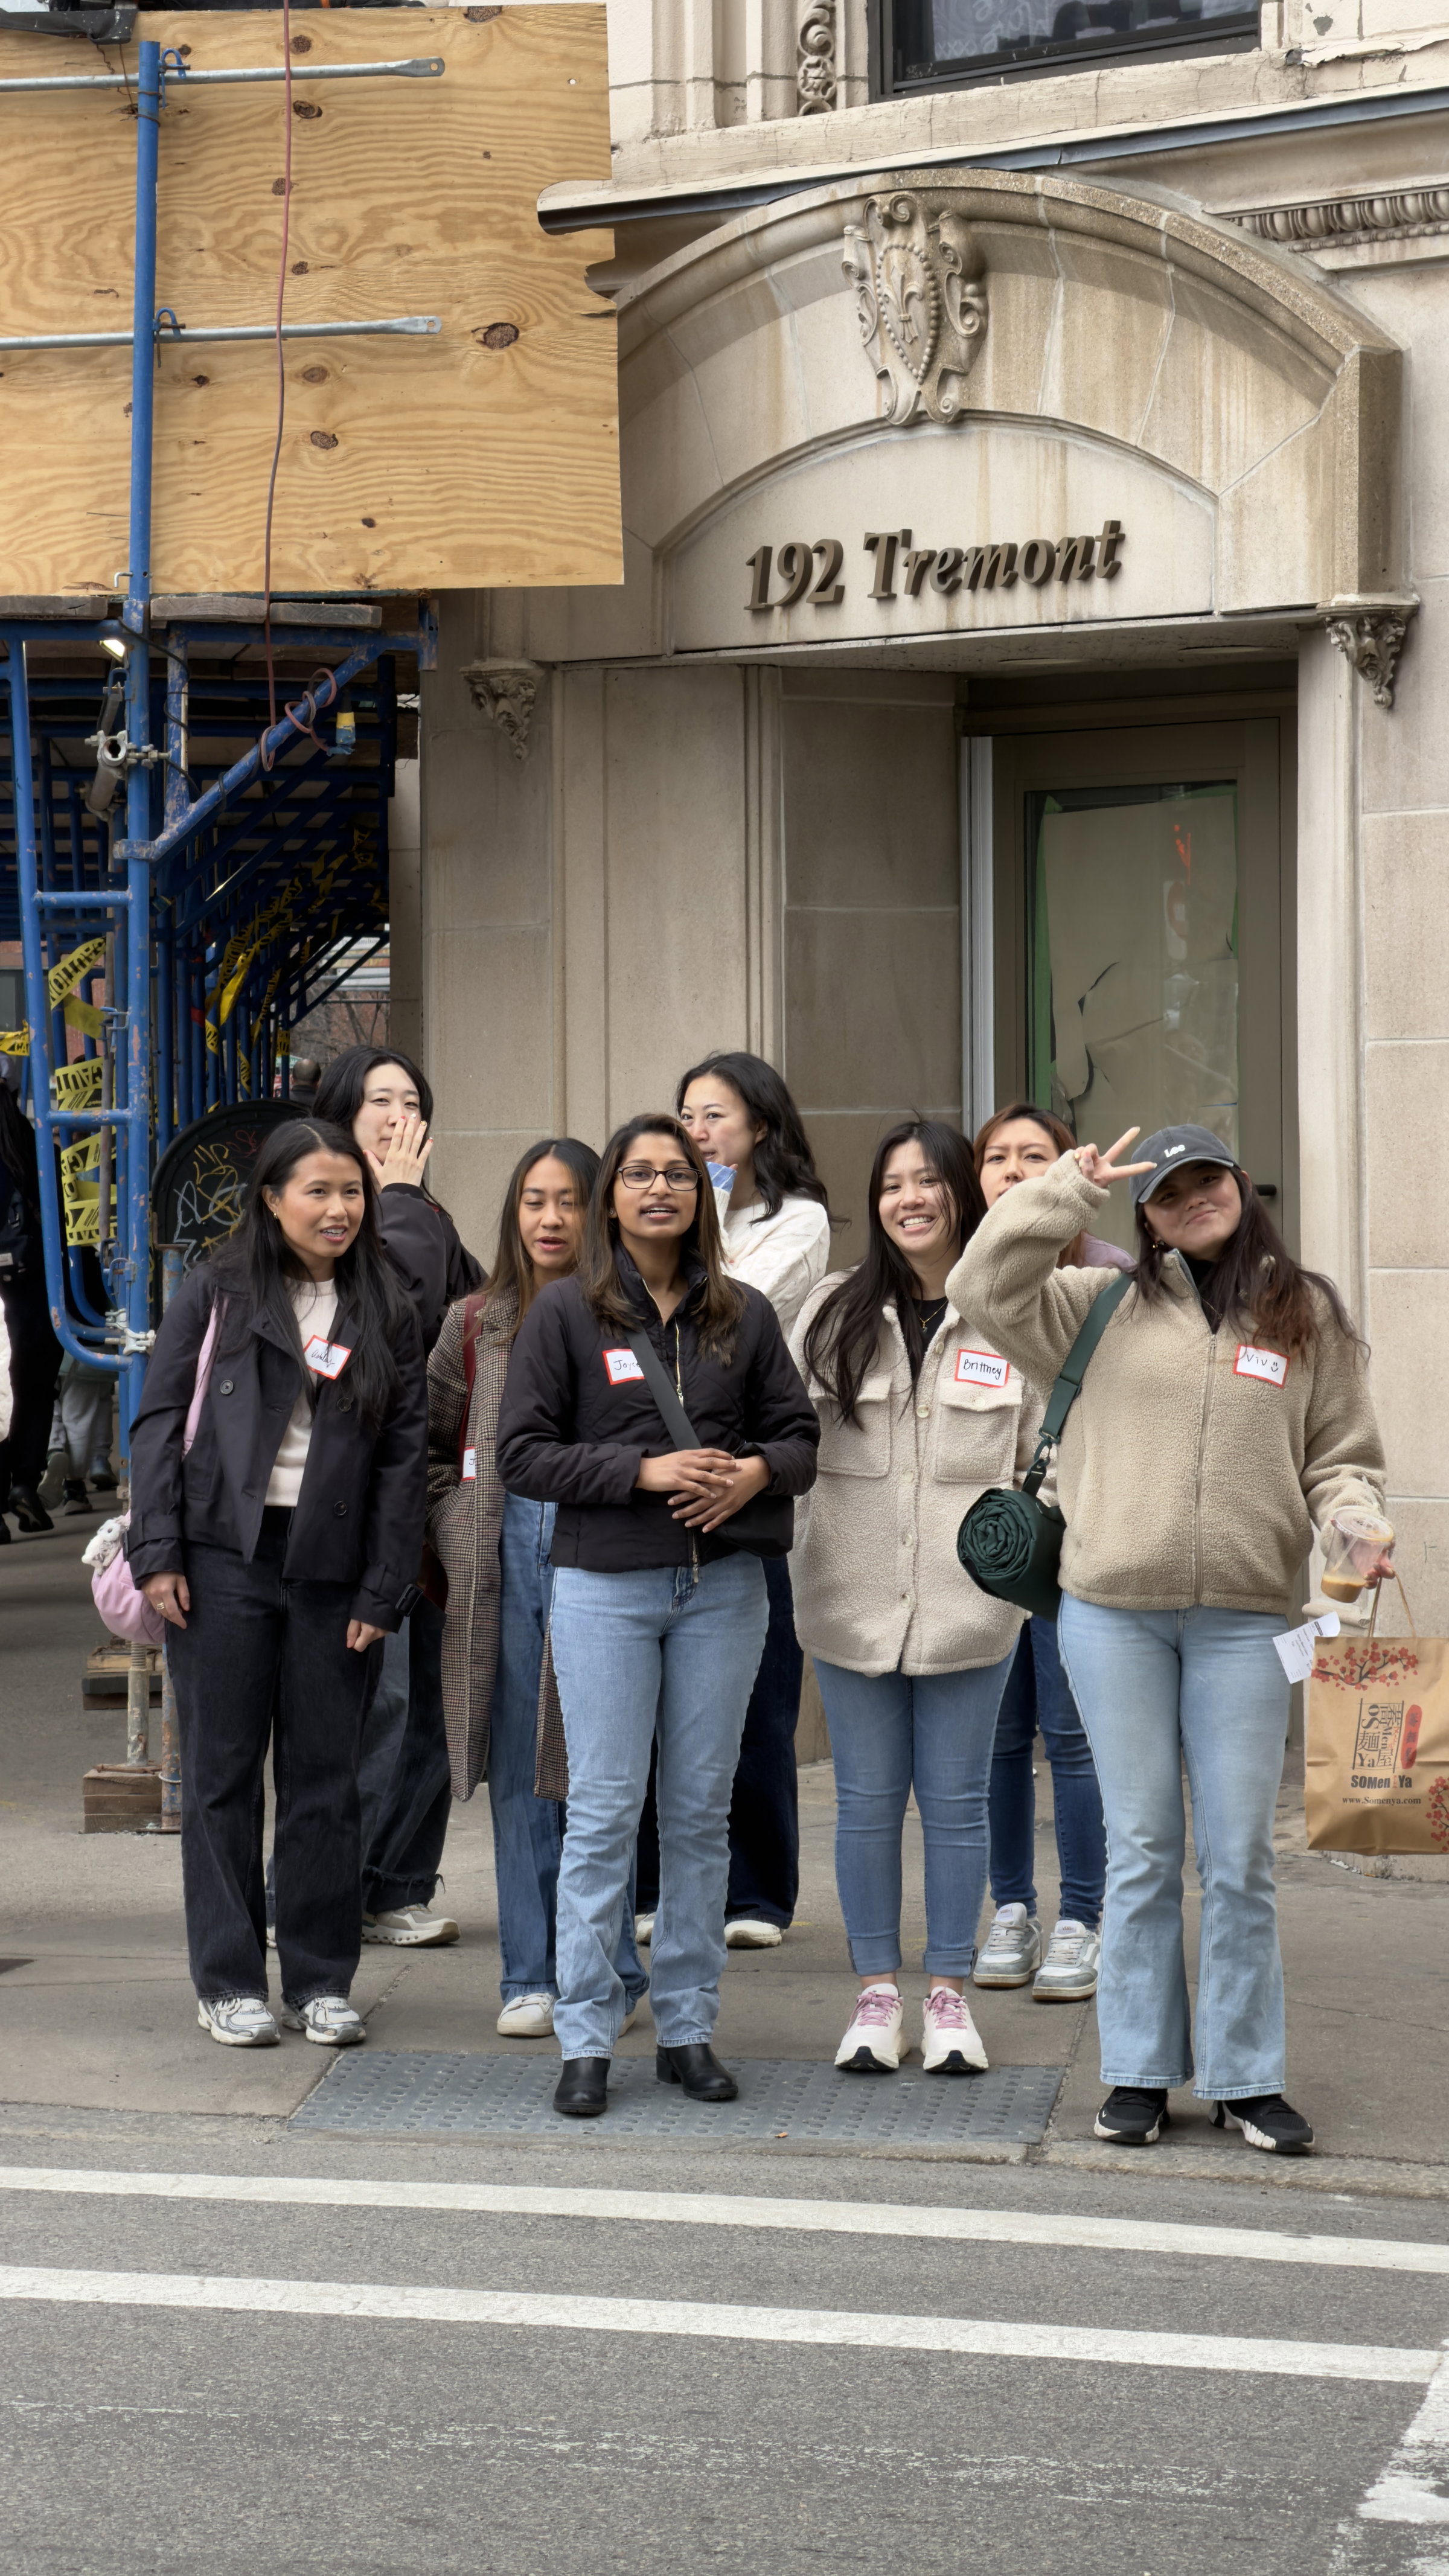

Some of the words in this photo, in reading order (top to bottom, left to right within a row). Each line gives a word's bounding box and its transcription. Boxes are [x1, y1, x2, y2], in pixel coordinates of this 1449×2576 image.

[744, 538, 845, 610] 192
[863, 520, 1125, 599] Tremont
[964, 1358, 1002, 1380] Brittney
[1398, 1775, 1413, 1788] Ya
